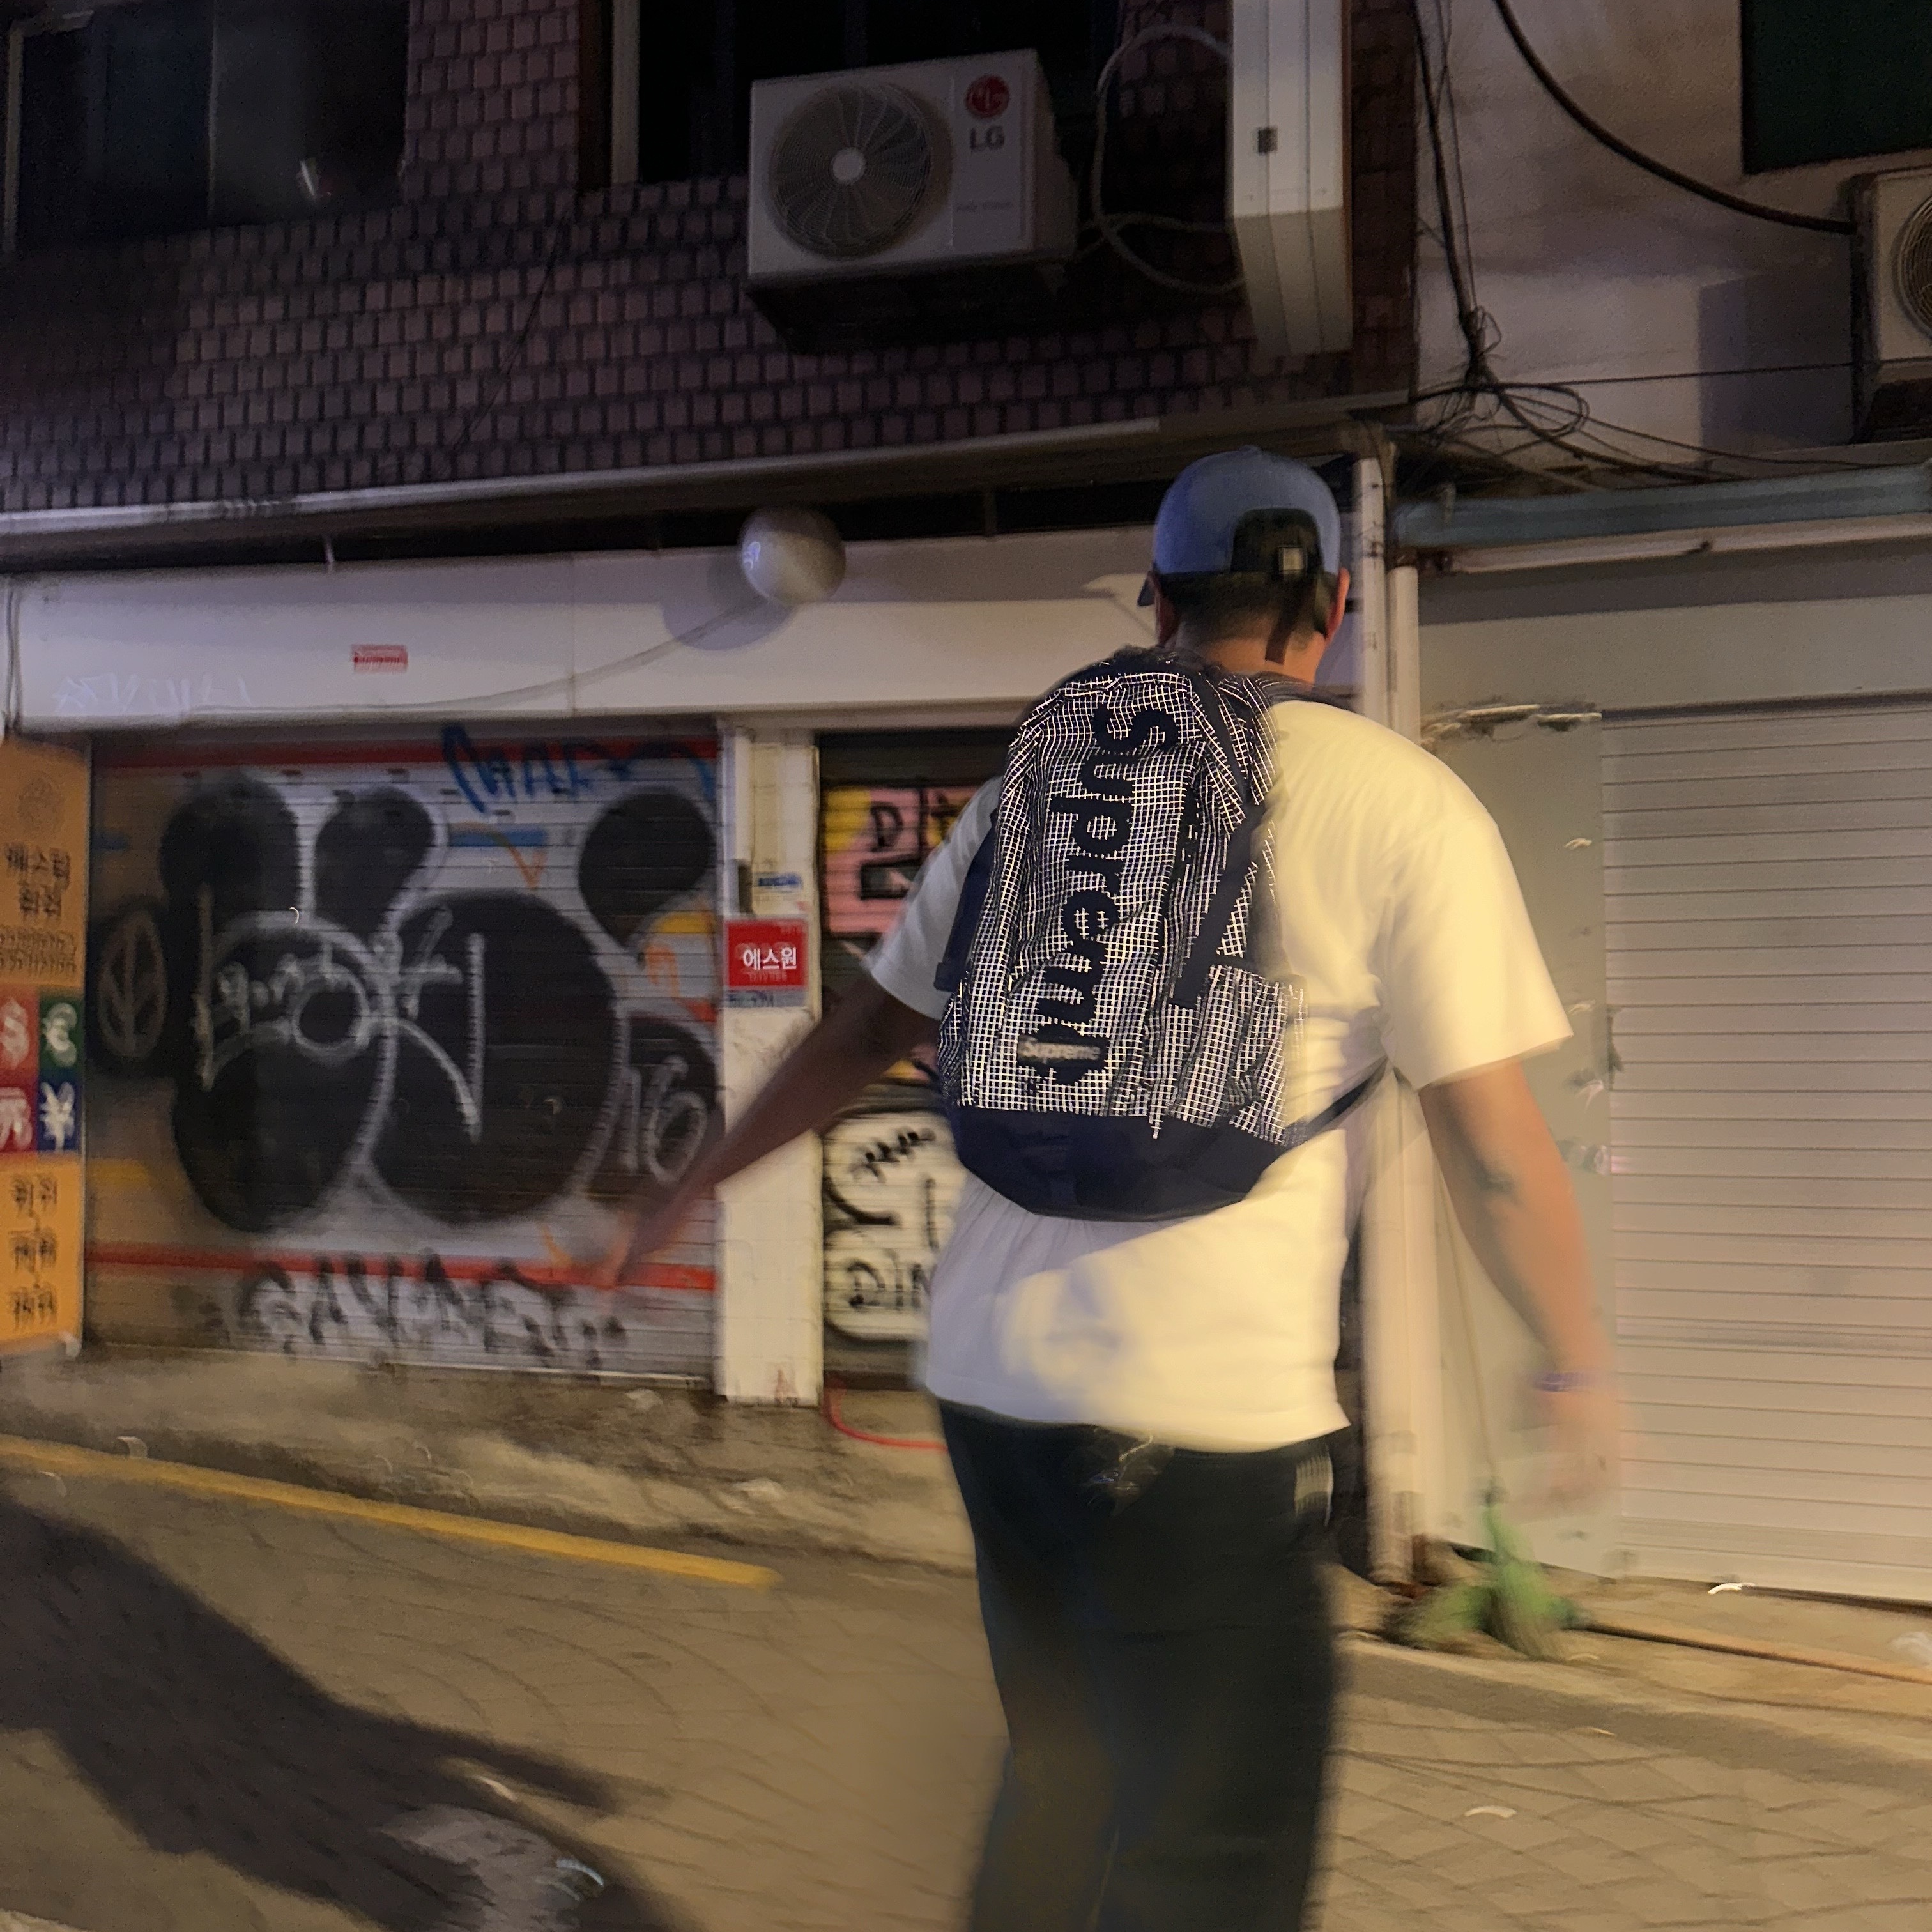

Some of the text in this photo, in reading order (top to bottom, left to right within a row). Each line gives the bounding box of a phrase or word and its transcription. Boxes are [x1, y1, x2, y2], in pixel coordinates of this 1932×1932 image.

[969, 126, 1005, 151] LG
[742, 946, 797, 970] 에스원
[1020, 1034, 1101, 1065] Supreme
